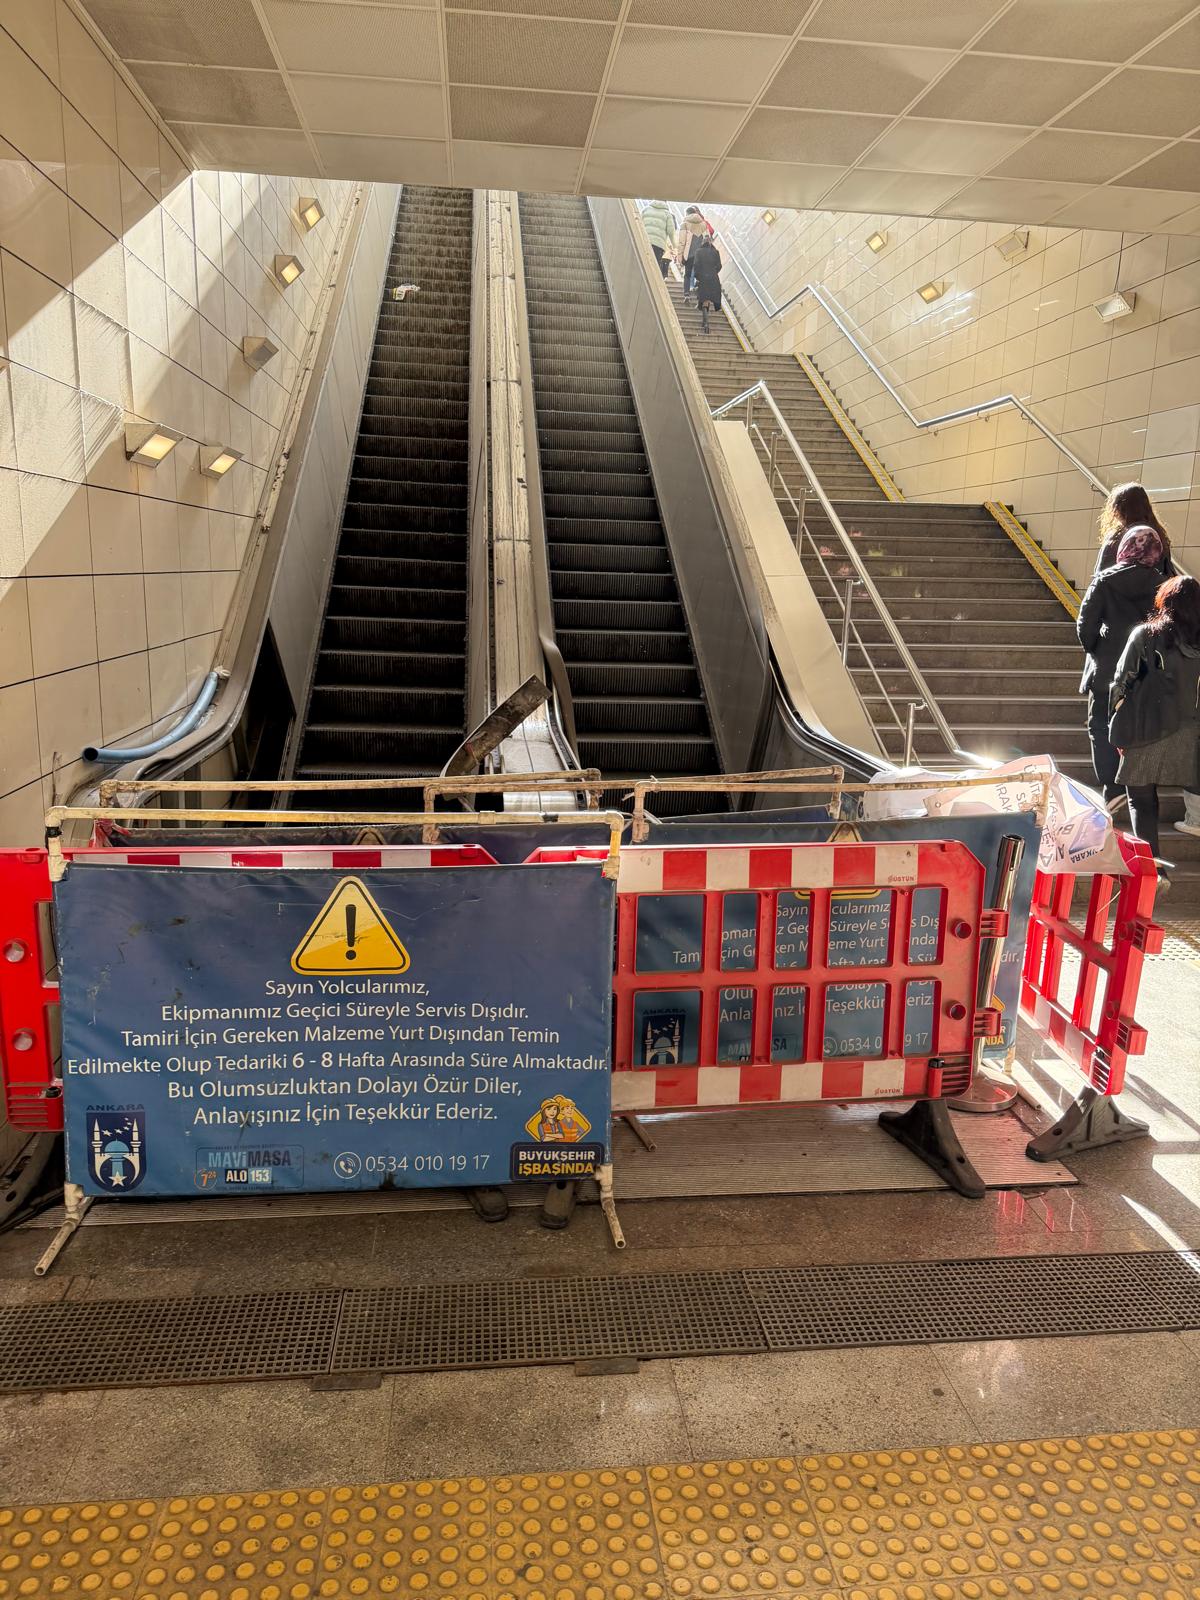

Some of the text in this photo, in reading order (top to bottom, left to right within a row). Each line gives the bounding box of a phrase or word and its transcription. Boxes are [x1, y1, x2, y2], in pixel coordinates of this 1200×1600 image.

[831, 902, 890, 915] cularımız
[830, 919, 877, 935] Süreyle
[721, 947, 739, 962] çin
[860, 937, 885, 949] Yurt
[265, 979, 430, 998] Sayın Yolcularımız,
[906, 993, 934, 1006] eriz.
[162, 1001, 529, 1024] Ekipmanımız Geçici Süreyle Servis Dışıdır.
[121, 1025, 560, 1049] Tamiri İçin Gereken Malzeme Yurt Dışından Temin
[840, 1037, 870, 1052] 0534
[915, 1032, 928, 1046] 17
[67, 1057, 161, 1075] Edilmekte
[166, 1056, 212, 1075] Olup
[216, 1053, 288, 1070] Tedariki
[292, 1052, 304, 1068] 6
[321, 1051, 333, 1068] 8
[338, 1051, 385, 1068] Hafta
[390, 1051, 465, 1068] Arasında
[470, 1052, 508, 1068] Süre
[512, 1053, 608, 1070] Almaktadır.
[168, 1073, 522, 1098] Bu Olumsuzluktan Dolayı Özür Diler,
[86, 1103, 145, 1112] ANKARA
[193, 1101, 498, 1128] Anlayışınız İçin Teşekkür Ederiz.
[248, 1149, 292, 1167] MASA
[365, 1154, 489, 1172] 0534 010 19 17
[226, 1169, 270, 1182] ALO 153
